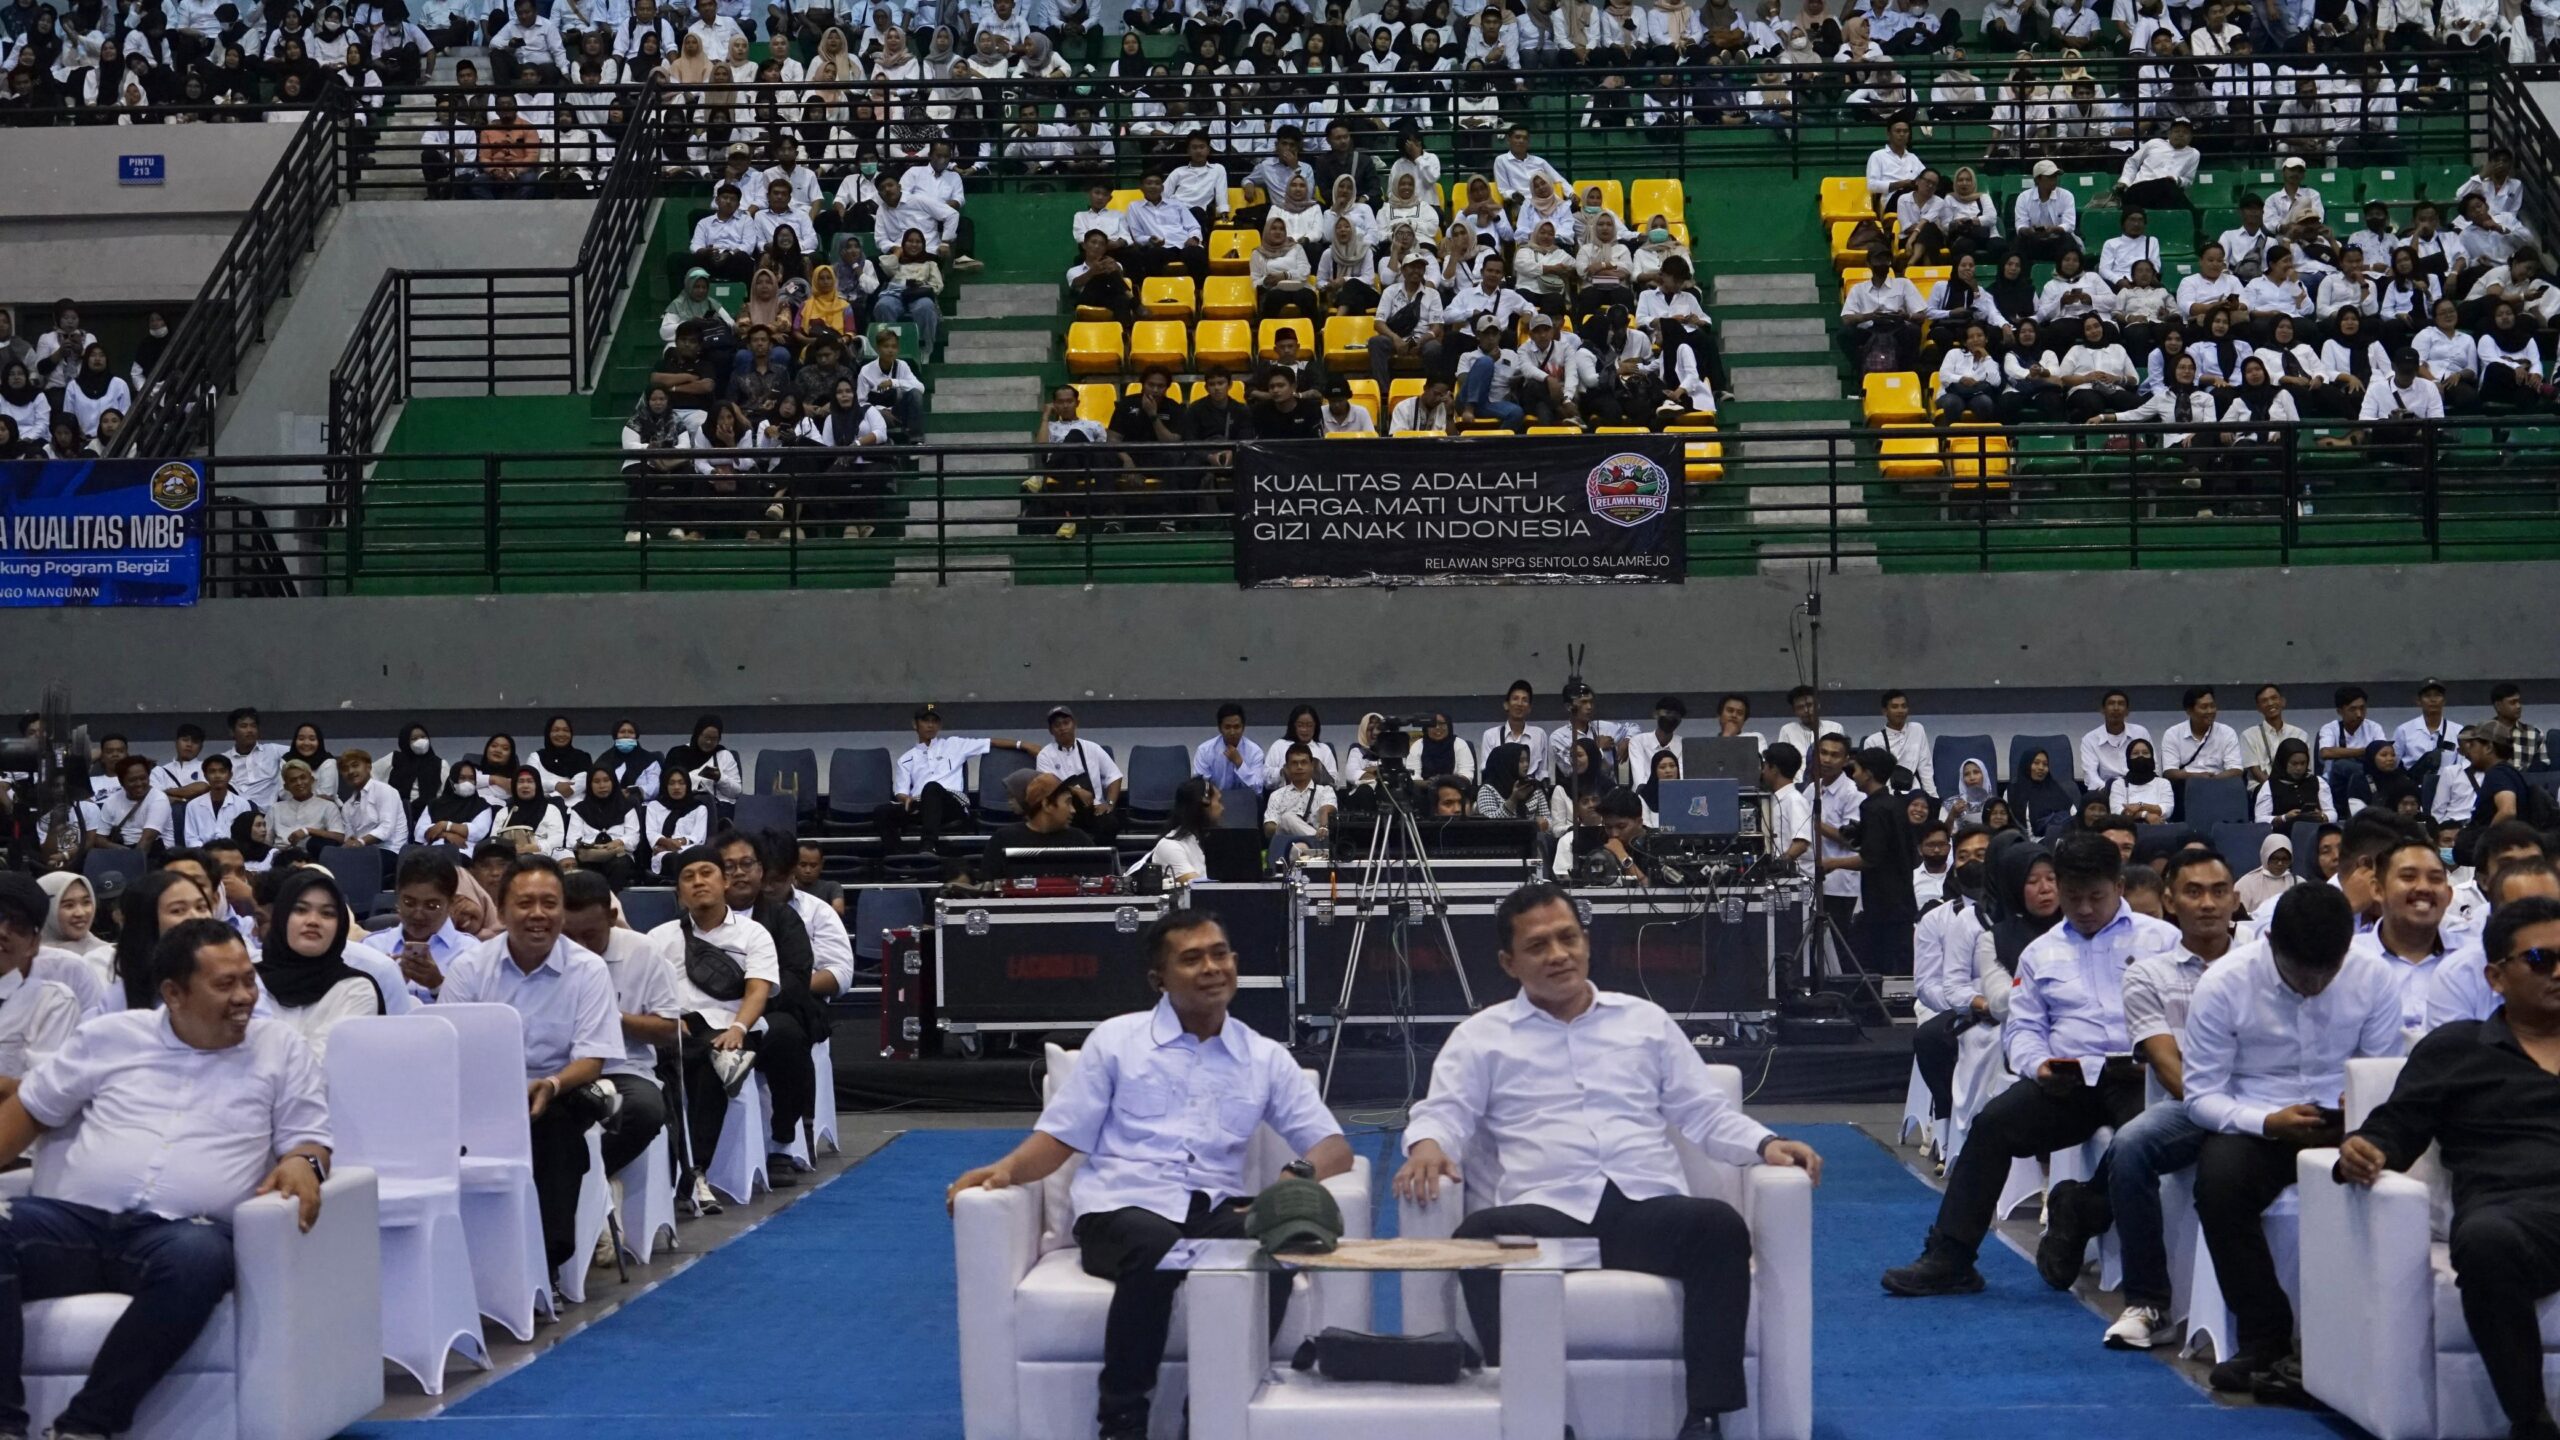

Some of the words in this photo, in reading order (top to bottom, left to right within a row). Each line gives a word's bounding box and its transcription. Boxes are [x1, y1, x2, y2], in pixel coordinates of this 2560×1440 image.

[129, 158, 154, 166] PINTU
[134, 167, 150, 176] 213
[1254, 473, 1401, 492] KUALITAS
[1411, 472, 1537, 490] ADALAH
[1254, 498, 1364, 516] HARGA
[1375, 497, 1445, 515] MATI
[1458, 495, 1566, 514] UNTUK
[1596, 497, 1636, 508] RELAWAN
[1637, 497, 1660, 507] MBG
[14, 515, 123, 550] KUALITAS
[130, 514, 184, 549] MBG
[1253, 522, 1310, 541] GIZI
[1321, 521, 1406, 540] ANAK
[1417, 519, 1591, 539] INDONESIA
[0, 561, 41, 577] kung
[45, 561, 113, 577] Program
[117, 559, 170, 575] Bergizi
[1425, 557, 1488, 569] RELAWAN
[1491, 556, 1526, 568] SPPG
[1528, 556, 1589, 568] SENTOLO
[1592, 555, 1670, 567] SALAMREJO
[27, 587, 100, 598] MANGUNAN
